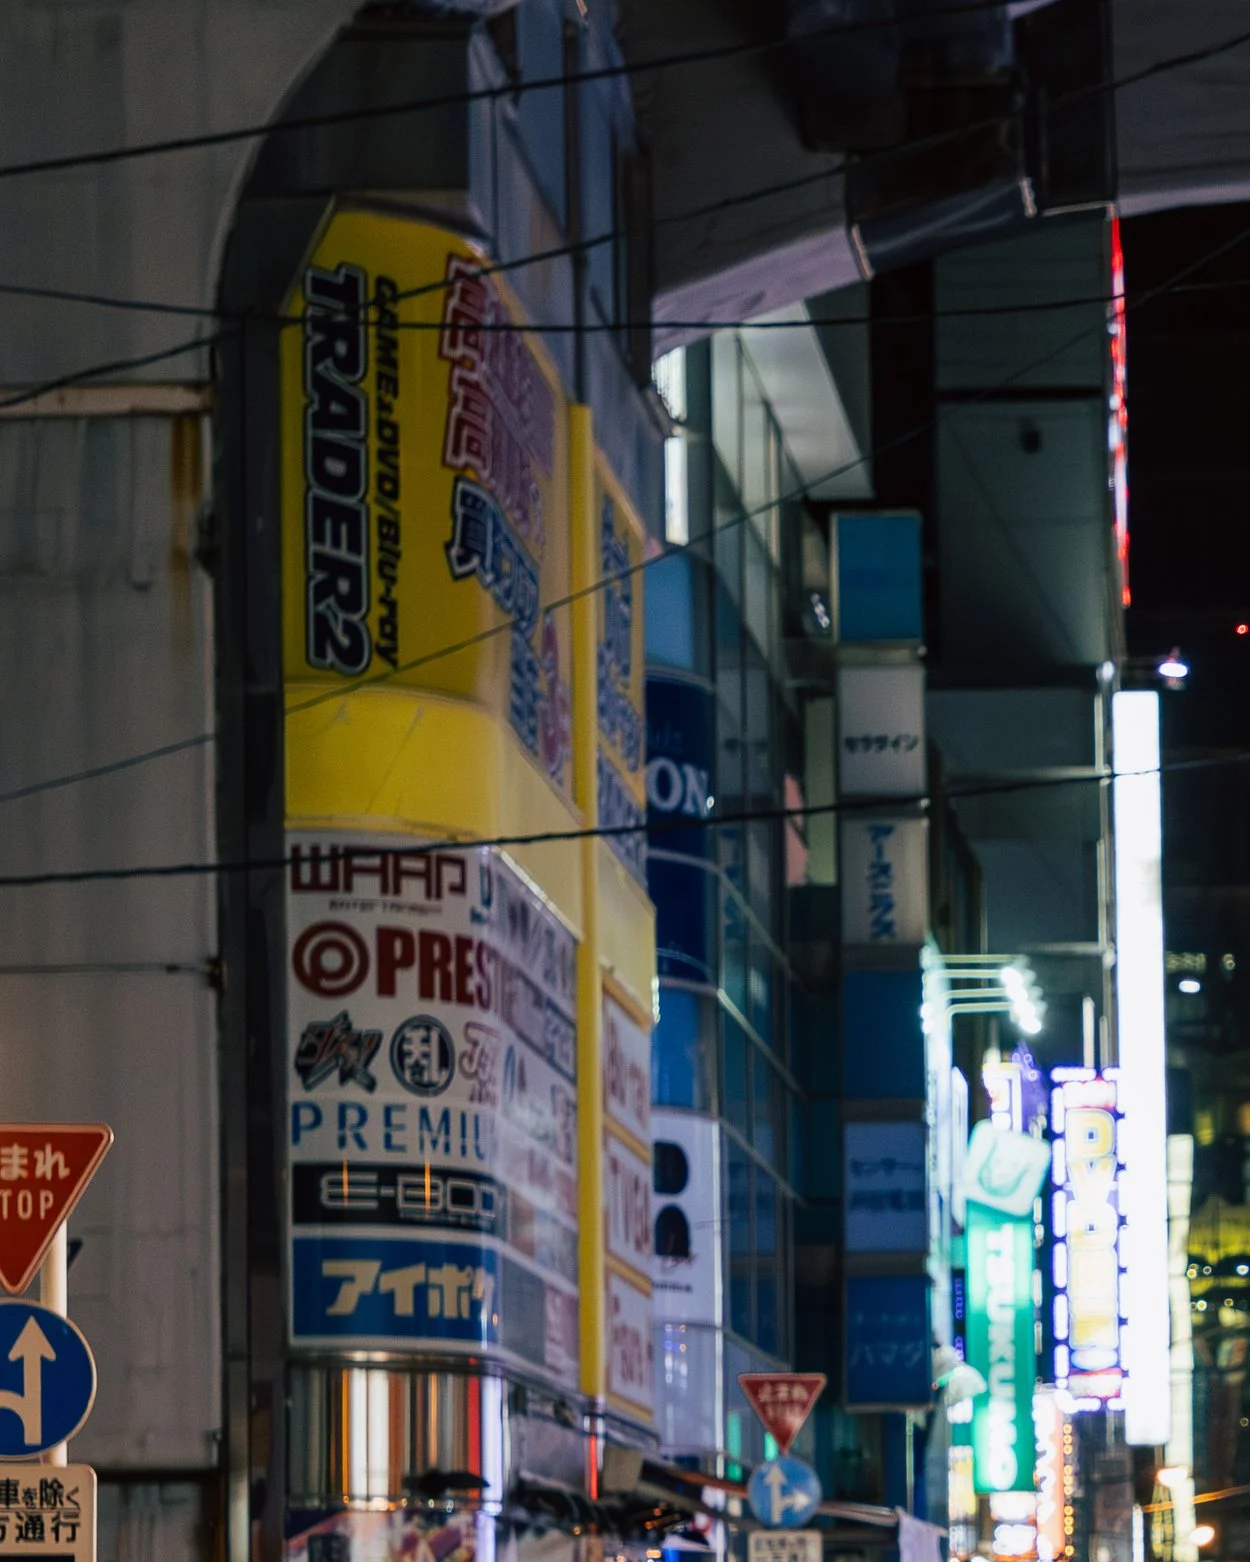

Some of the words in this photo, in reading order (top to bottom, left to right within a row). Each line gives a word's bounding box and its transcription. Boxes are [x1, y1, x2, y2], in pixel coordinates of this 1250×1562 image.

[307, 264, 371, 676] TRADER2
[0, 1142, 71, 1181] まれ
[0, 1189, 54, 1220] TOP
